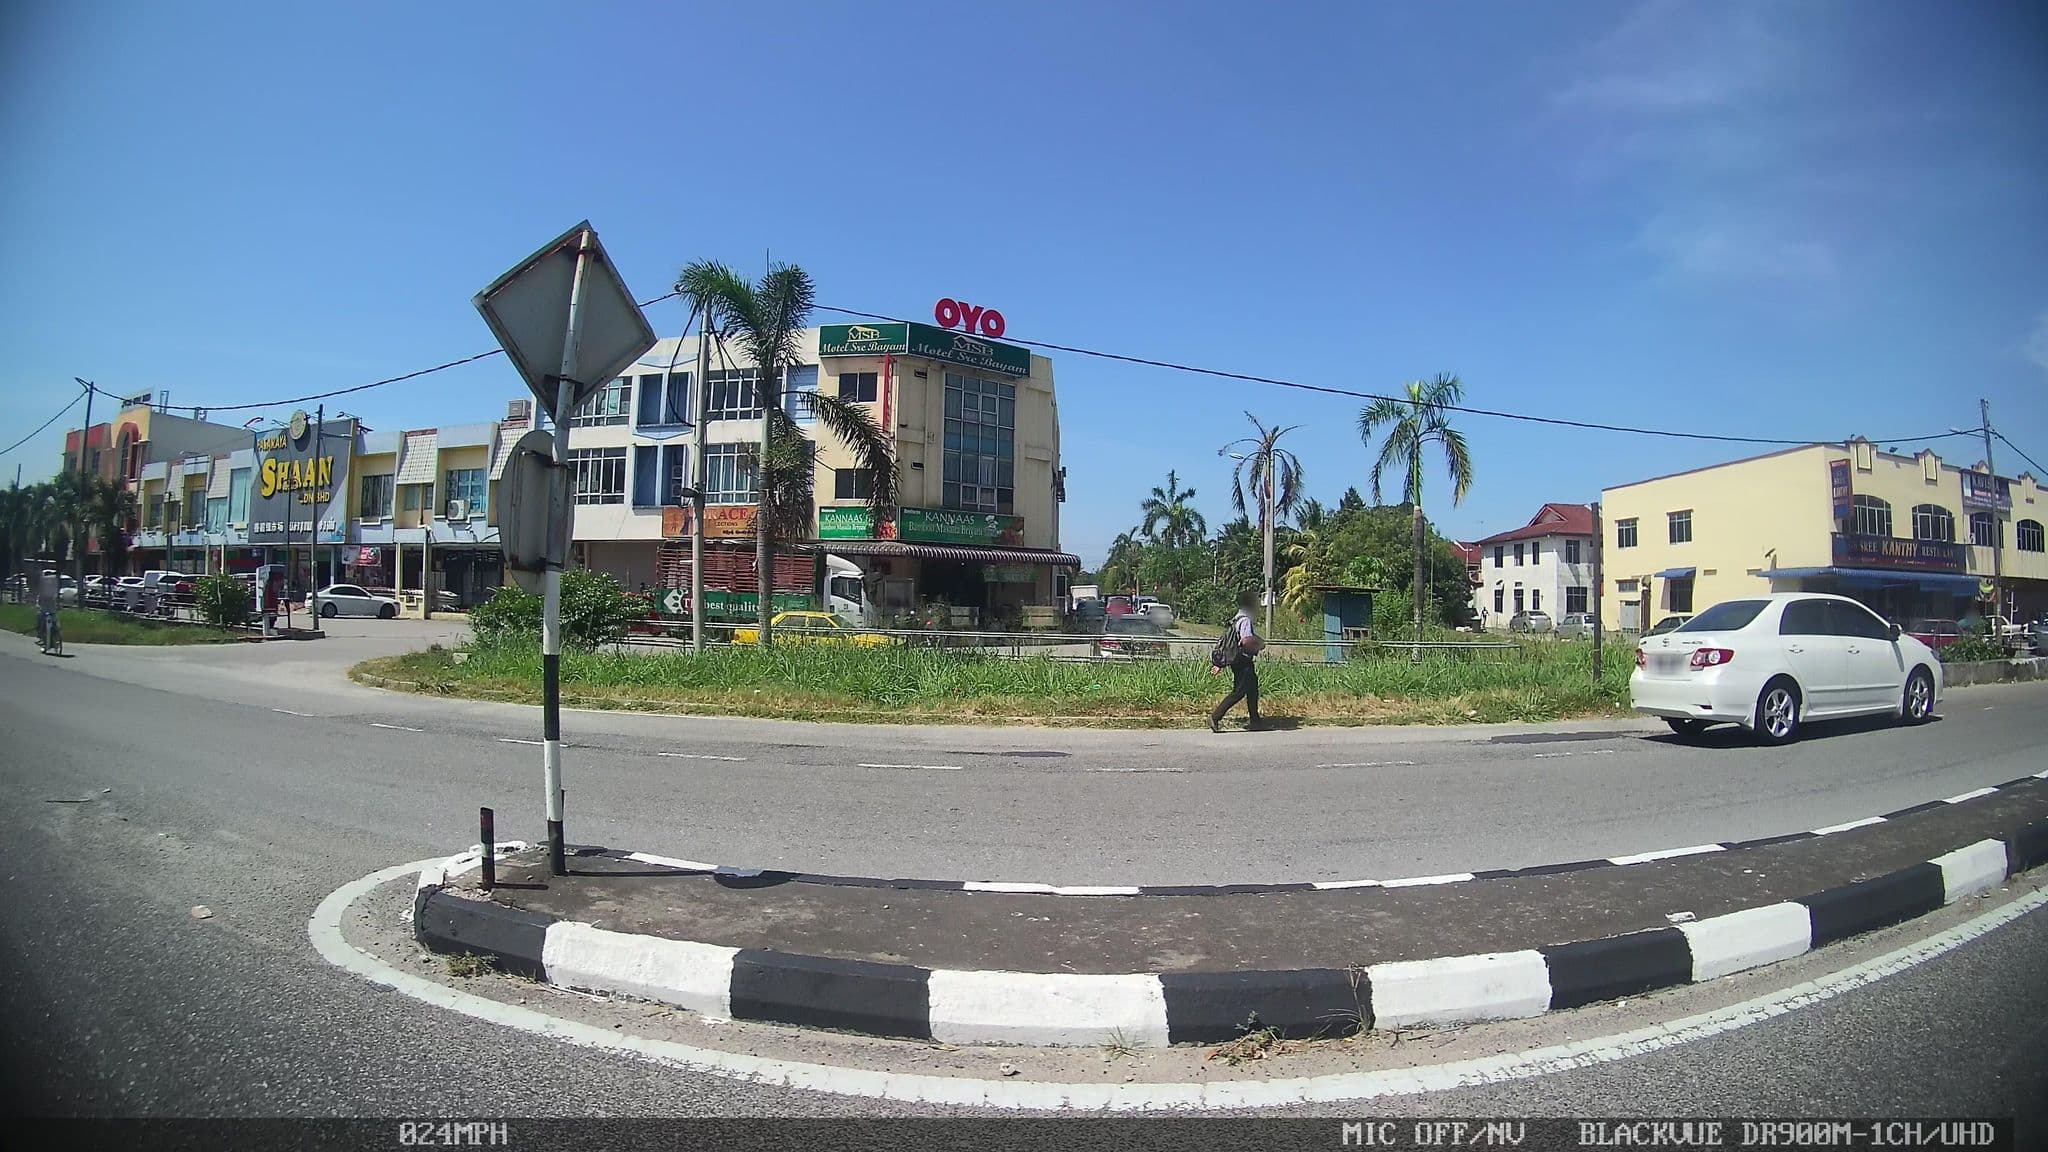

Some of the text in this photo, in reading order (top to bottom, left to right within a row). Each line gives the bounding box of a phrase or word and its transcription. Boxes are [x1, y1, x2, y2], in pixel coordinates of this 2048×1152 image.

[935, 298, 1006, 339] OYO
[848, 330, 881, 341] MSB
[820, 342, 849, 354] Motel
[868, 342, 906, 355] Bayam
[952, 339, 994, 357] MSB
[912, 342, 953, 360] Motel
[980, 356, 1028, 376] Bayam
[262, 456, 333, 497] SHAAN
[825, 513, 863, 522] KANNAAS
[925, 511, 975, 525] KANNAAS
[1882, 540, 1918, 558] KANTHY
